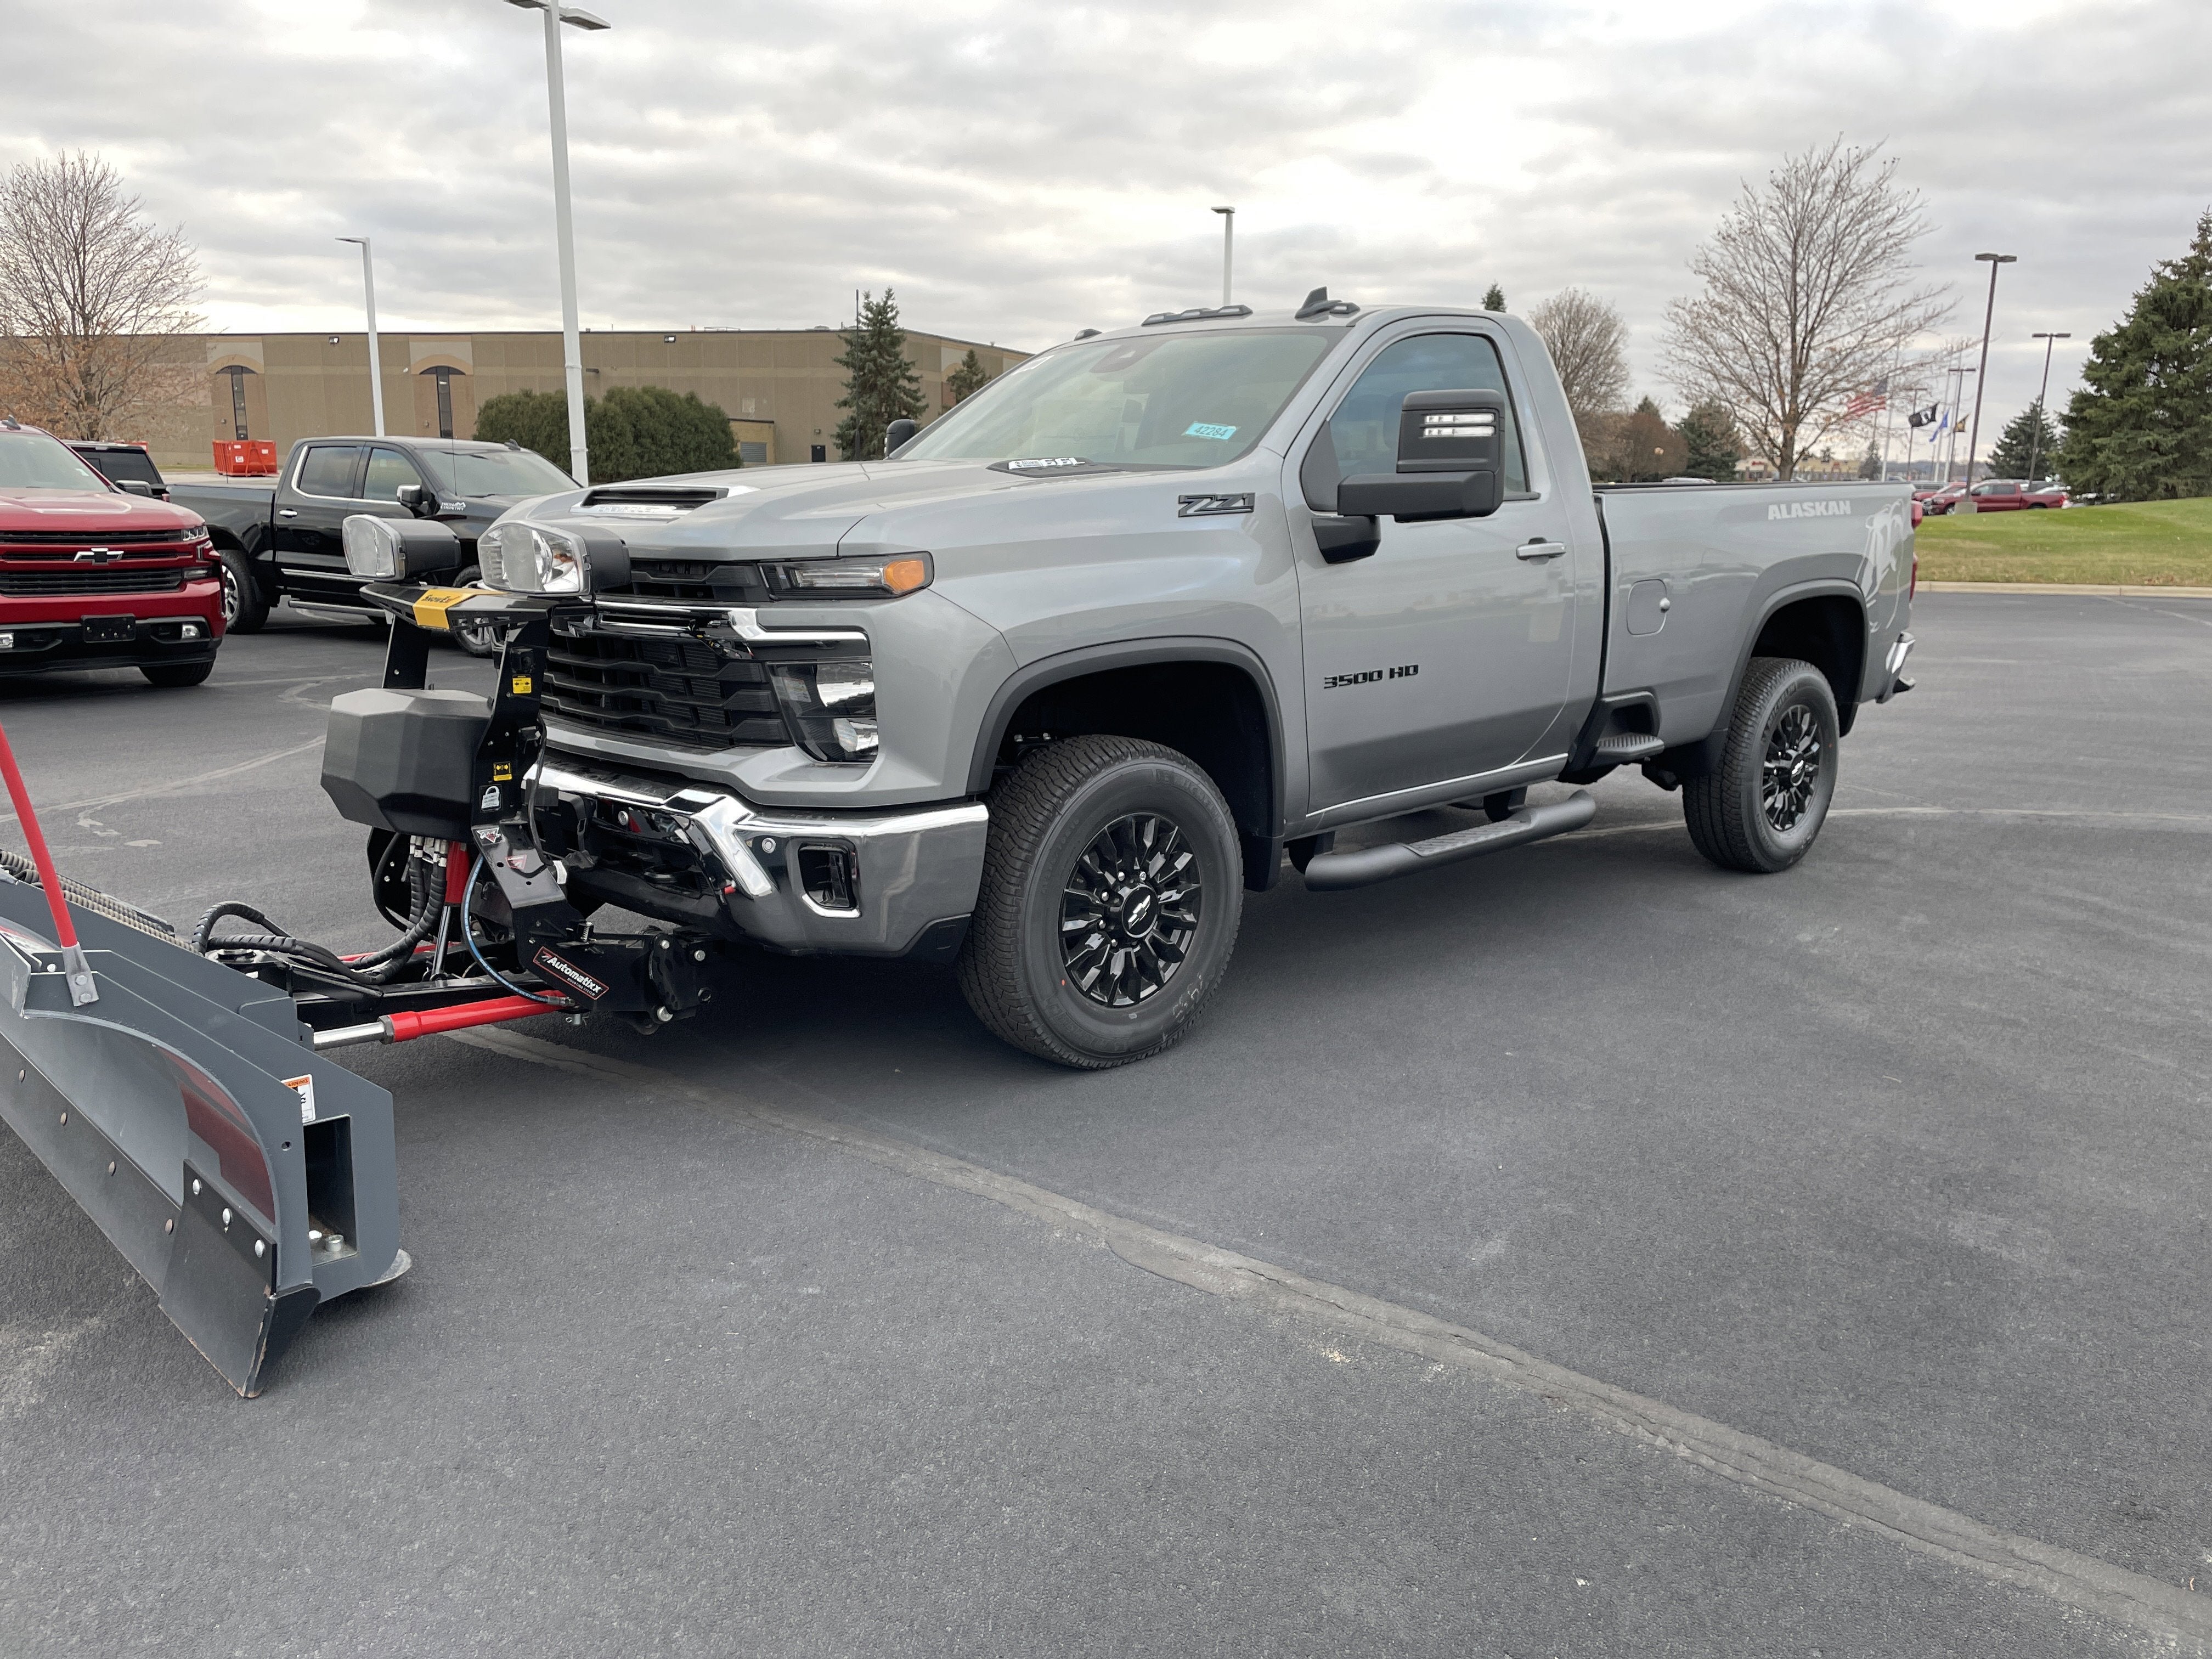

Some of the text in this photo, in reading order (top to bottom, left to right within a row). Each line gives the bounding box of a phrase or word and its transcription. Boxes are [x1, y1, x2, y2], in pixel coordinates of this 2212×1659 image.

[1194, 425, 1228, 437] 42284
[1178, 492, 1255, 518] Z71
[1768, 500, 1852, 520] ALASKAN
[1324, 664, 1419, 689] 3500 HD
[547, 957, 601, 993] Automatixx
